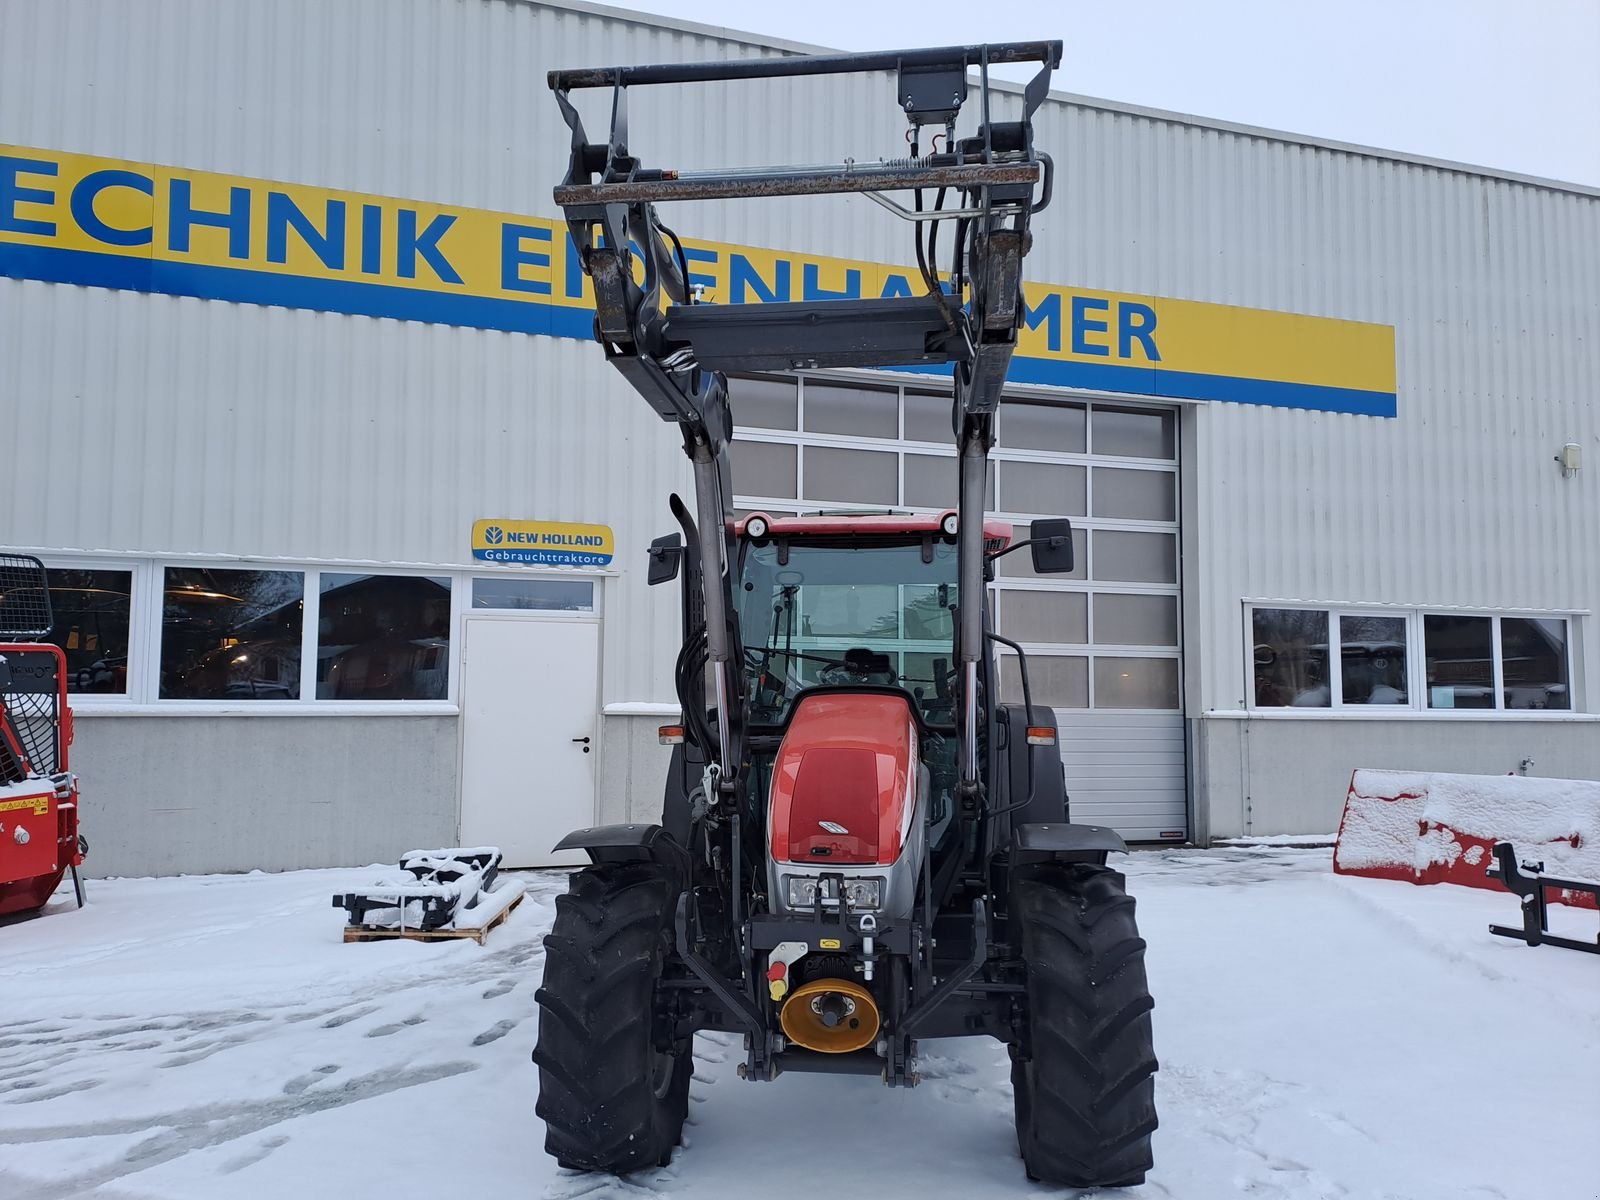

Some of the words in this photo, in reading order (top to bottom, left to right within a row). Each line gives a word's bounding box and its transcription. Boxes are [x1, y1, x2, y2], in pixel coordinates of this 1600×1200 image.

[0, 155, 465, 285] ECHNIK
[507, 532, 538, 544] NEW
[542, 534, 603, 546] HOLLAND
[485, 550, 604, 564] Gebrauchttraktore
